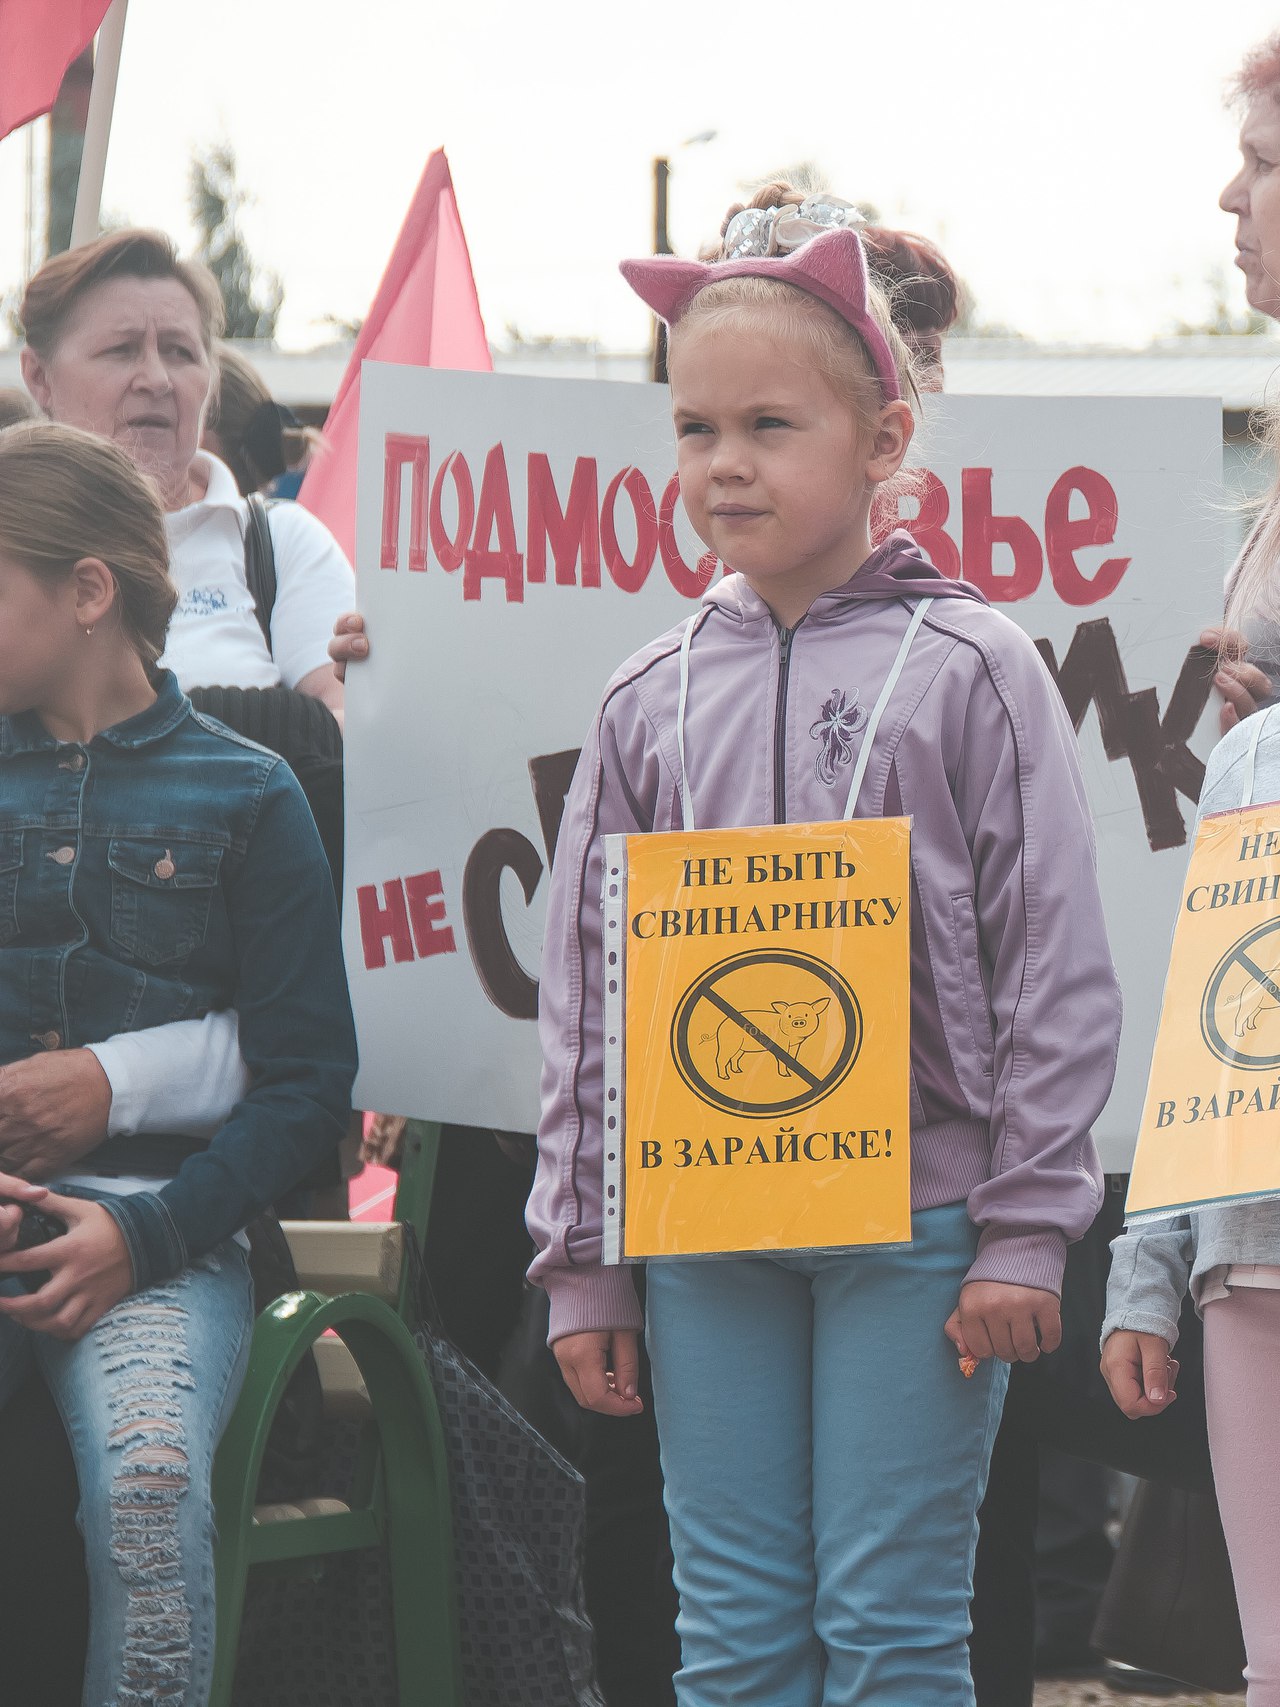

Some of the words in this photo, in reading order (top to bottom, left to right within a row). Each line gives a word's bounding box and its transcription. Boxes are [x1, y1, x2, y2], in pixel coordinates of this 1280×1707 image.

[681, 856, 733, 887] НЕ
[745, 850, 856, 884] БЫТЬ
[356, 868, 457, 971] НЕ
[631, 896, 902, 939] СВИНАРНИКУ
[1155, 1100, 1176, 1129] В
[639, 1140, 662, 1169] В
[673, 1126, 893, 1168] ЗАРАЙСКЕ!
